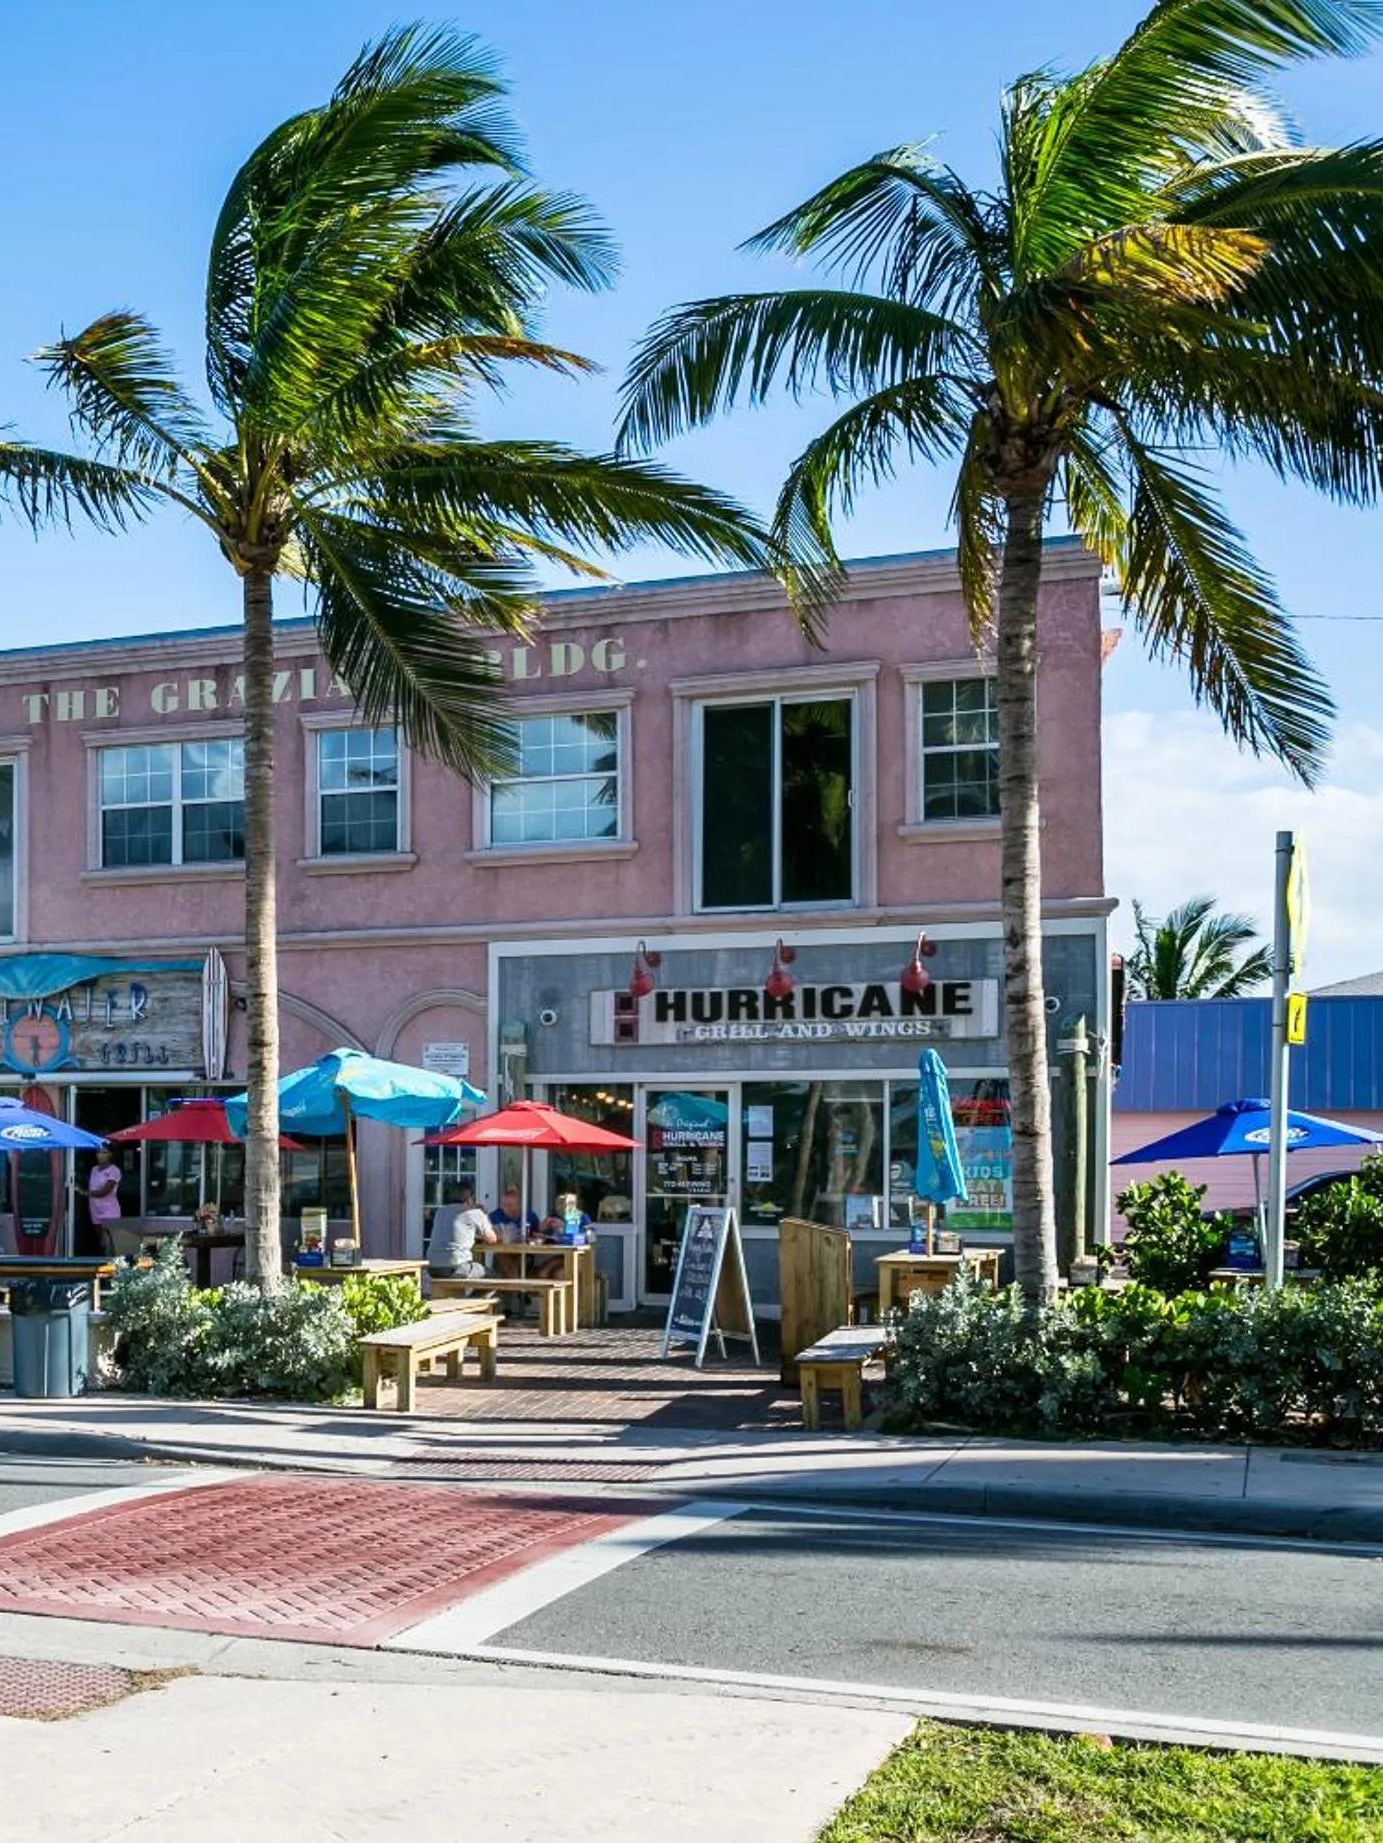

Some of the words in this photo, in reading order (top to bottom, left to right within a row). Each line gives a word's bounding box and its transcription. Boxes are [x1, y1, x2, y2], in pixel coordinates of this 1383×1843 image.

[21, 686, 120, 724] THE
[150, 667, 357, 714] GRAZIA
[655, 982, 974, 1023] HURRICANE
[695, 1023, 768, 1040] GRILL
[777, 1022, 832, 1038] AND
[843, 1020, 931, 1037] WINGS
[662, 1131, 725, 1142] HURRICANE
[966, 1179, 997, 1193] EAT
